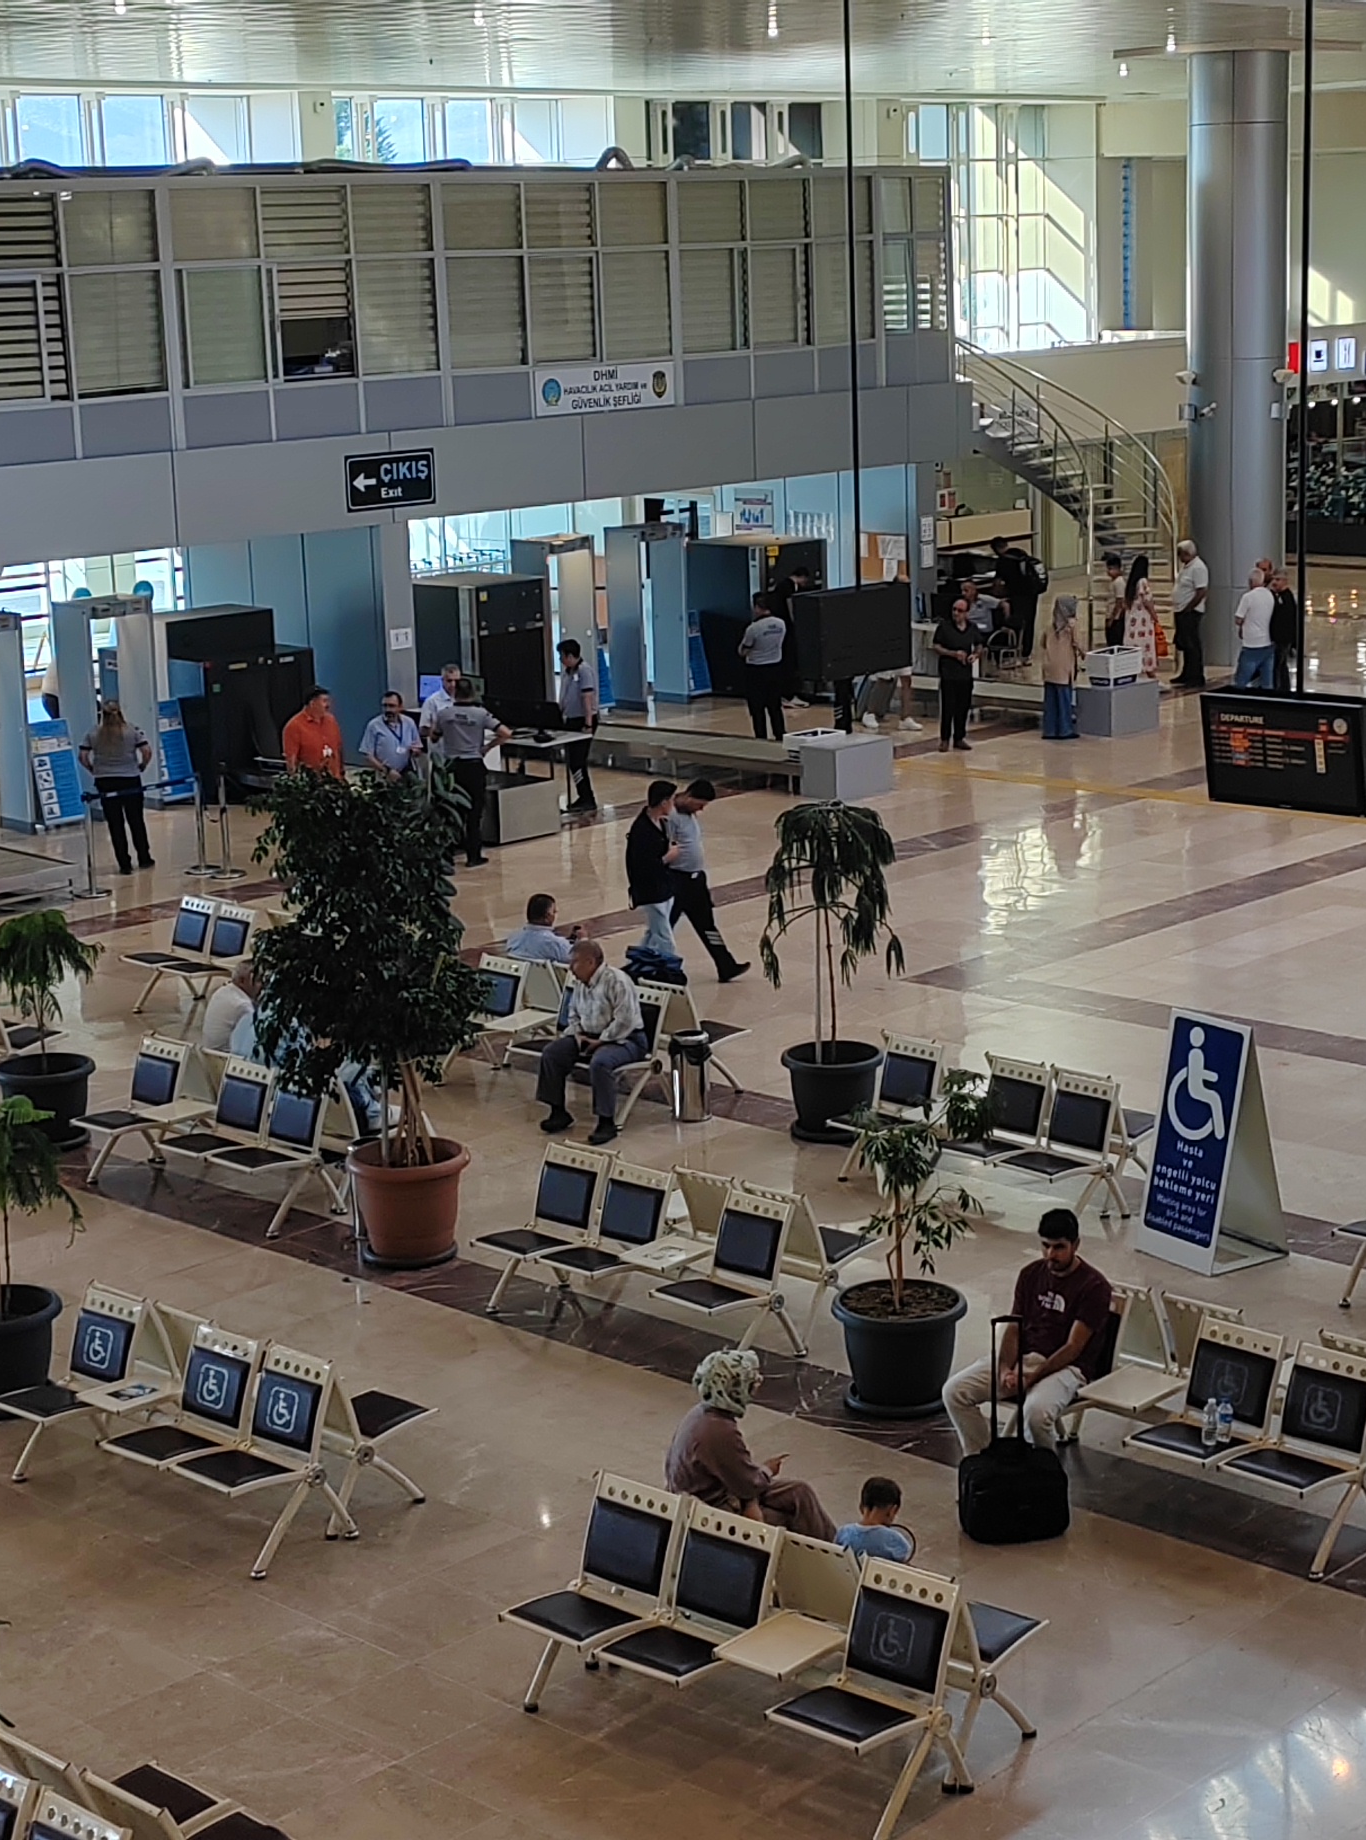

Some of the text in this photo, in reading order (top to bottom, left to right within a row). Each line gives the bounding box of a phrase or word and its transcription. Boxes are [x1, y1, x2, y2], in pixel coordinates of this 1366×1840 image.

[593, 366, 618, 381] DHMİ
[572, 392, 642, 410] GÜVENLİK ŞEFLİĞİ
[380, 460, 428, 483] ÇIKIŞ
[380, 486, 402, 498] Exit
[1220, 713, 1264, 725] DEPARTURE
[1176, 1140, 1204, 1158] Hasta
[1182, 1158, 1193, 1168] ve
[1156, 1164, 1216, 1190] engelli yolcu
[1154, 1175, 1214, 1204] bekleme yeri
